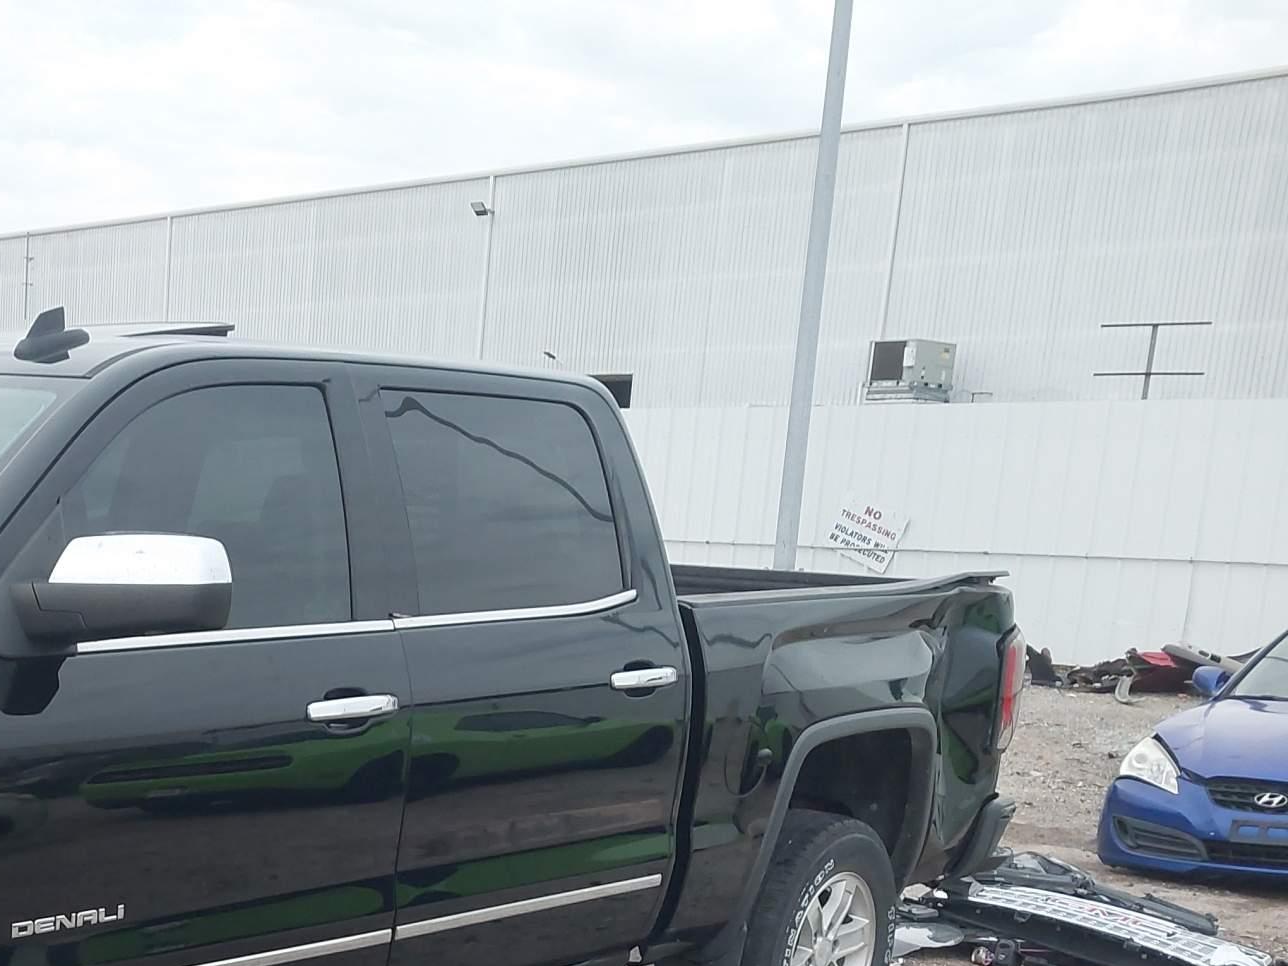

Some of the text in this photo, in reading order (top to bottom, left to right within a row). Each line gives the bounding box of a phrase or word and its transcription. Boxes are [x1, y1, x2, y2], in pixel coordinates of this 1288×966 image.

[840, 508, 897, 541] TRESPASSING
[864, 506, 882, 520] NO
[829, 532, 840, 545] BE
[834, 522, 872, 546] VIOLATORS
[11, 903, 125, 939] DENALI
